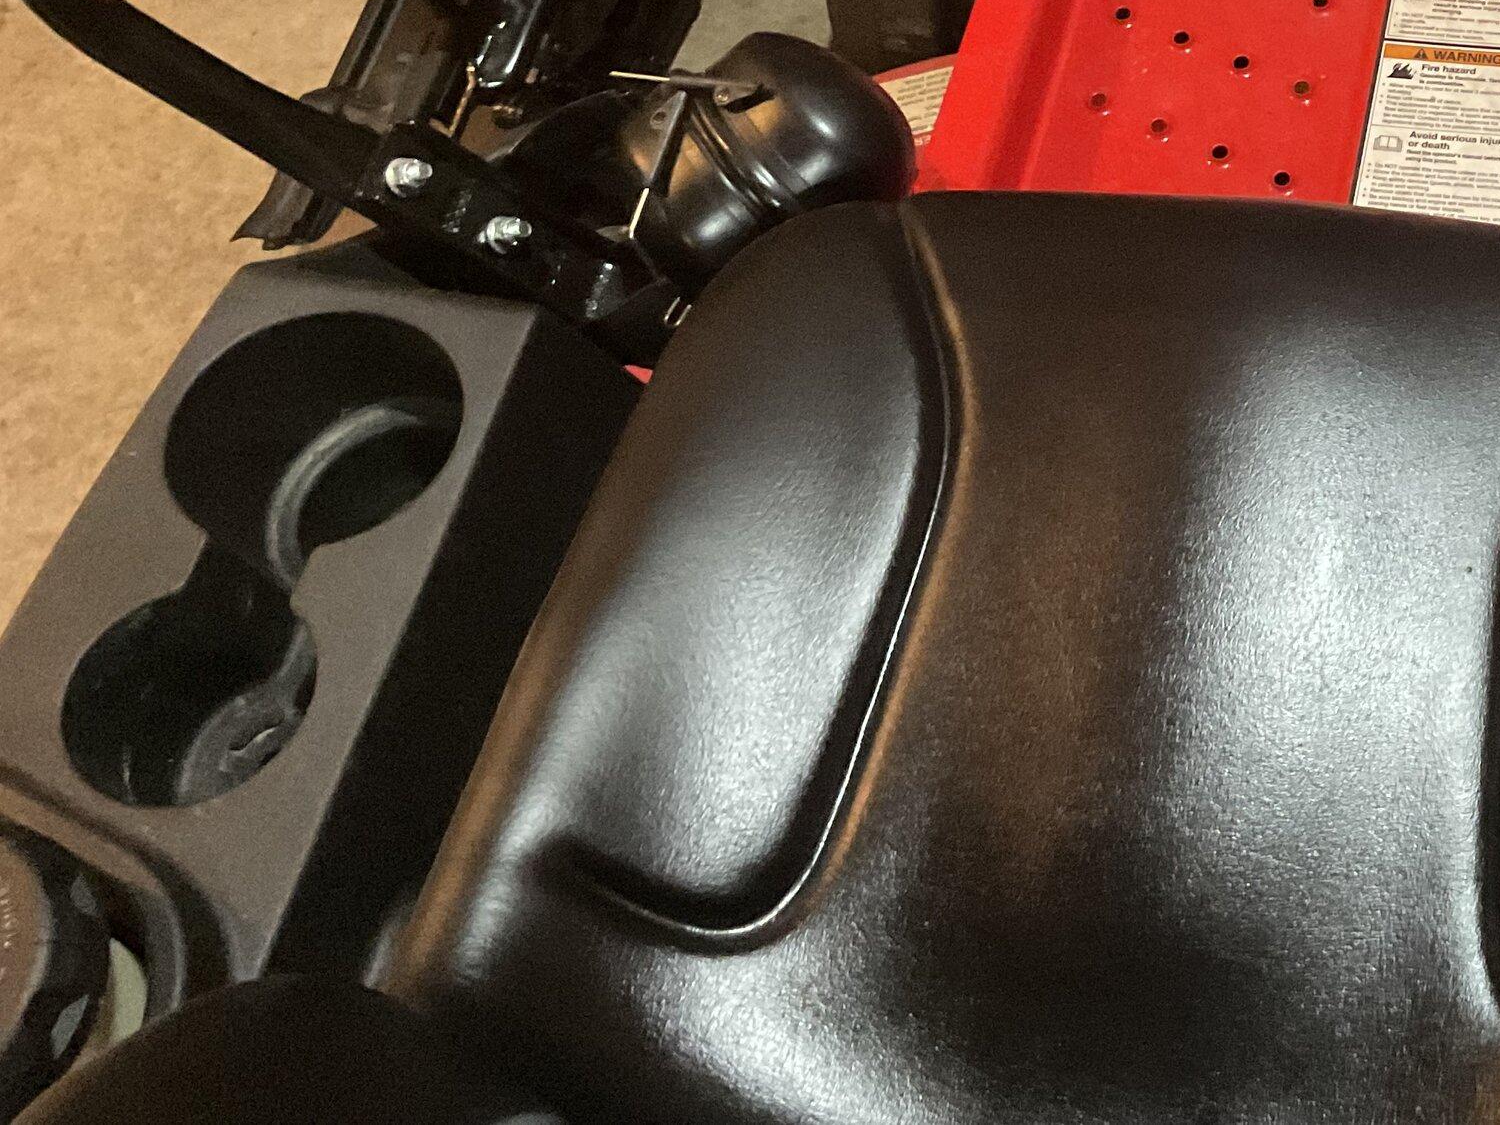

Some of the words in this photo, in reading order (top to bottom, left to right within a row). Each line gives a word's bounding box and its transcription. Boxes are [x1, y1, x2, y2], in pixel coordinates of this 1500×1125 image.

[1421, 64, 1440, 72] Fire
[1442, 66, 1476, 75] hazard
[1409, 131, 1438, 140] Avoid
[1440, 135, 1477, 143] serious
[1421, 141, 1450, 150] death
